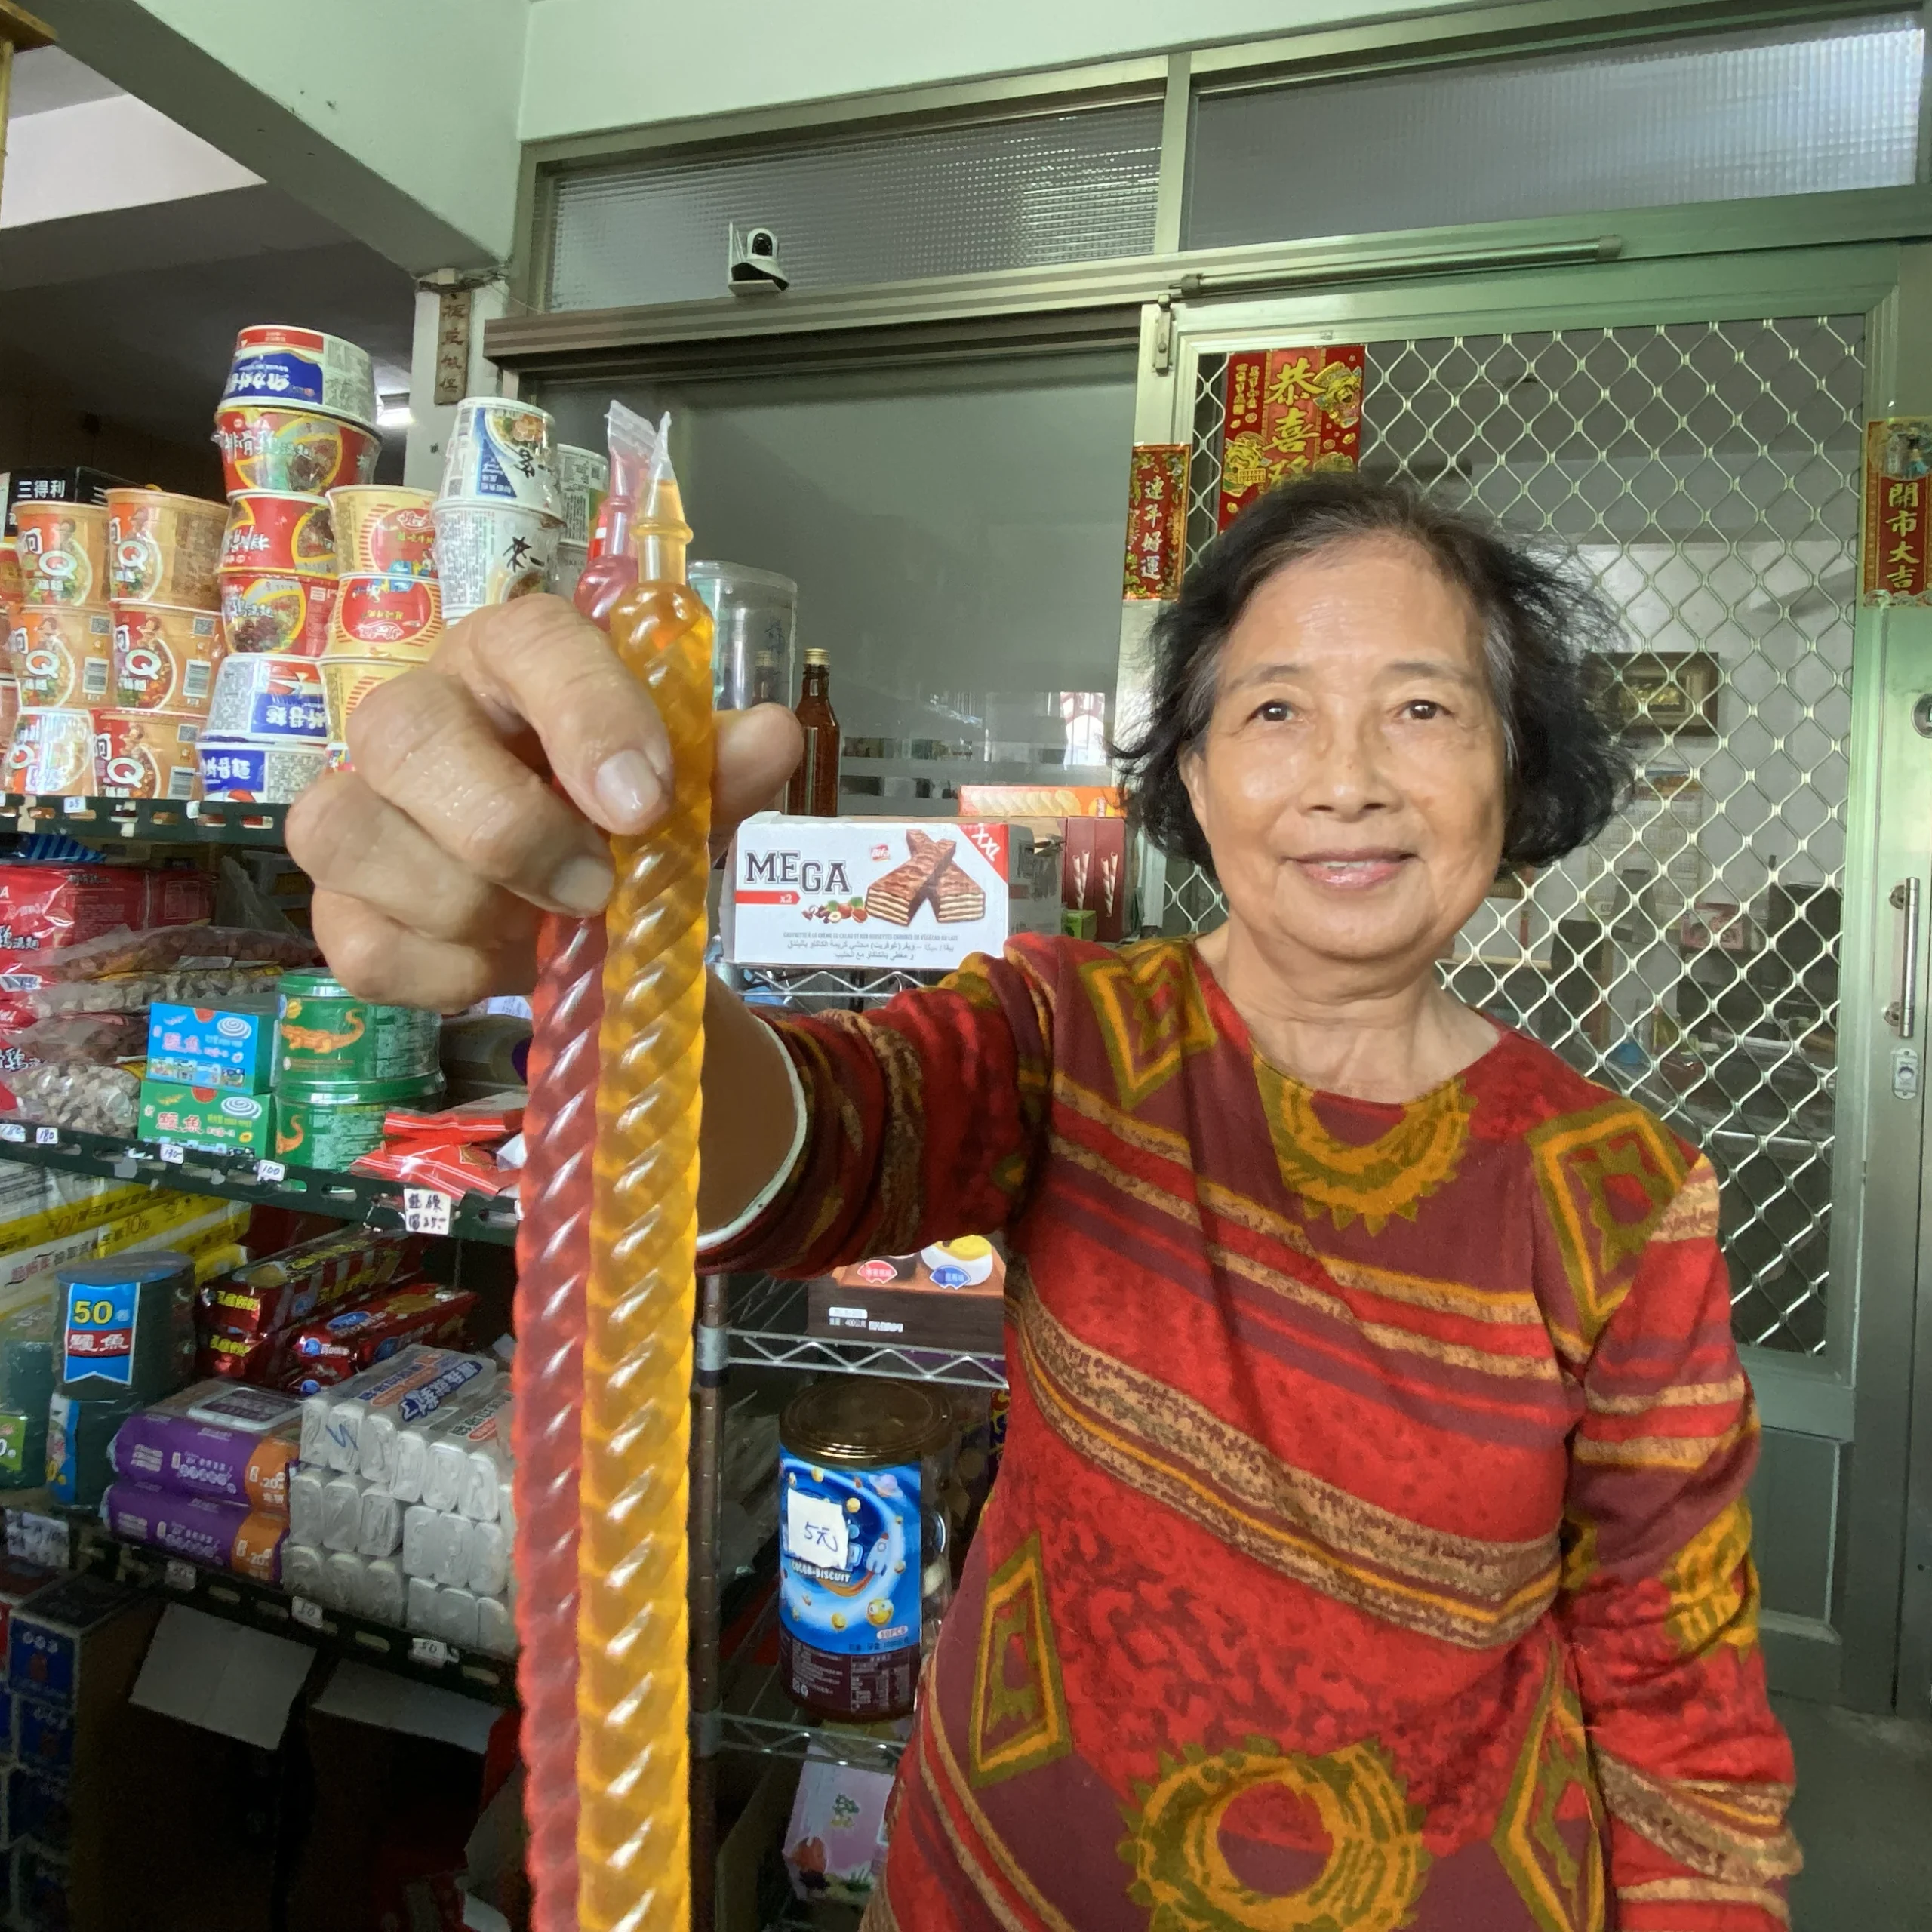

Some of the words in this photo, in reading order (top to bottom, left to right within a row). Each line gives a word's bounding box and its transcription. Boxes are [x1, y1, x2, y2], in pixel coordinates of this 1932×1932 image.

[17, 479, 66, 498] 三得利
[1140, 475, 1166, 580] 連年好運
[1885, 483, 1920, 589] 開市大吉
[38, 549, 77, 580] Q
[117, 540, 149, 571] Q
[26, 649, 60, 680] Q
[125, 648, 162, 681] Q
[107, 757, 146, 789] Q
[971, 824, 1002, 862] XXL
[744, 850, 852, 895] MEGA
[780, 894, 794, 903] x2
[262, 1165, 281, 1177] 100
[73, 1300, 114, 1325] 50
